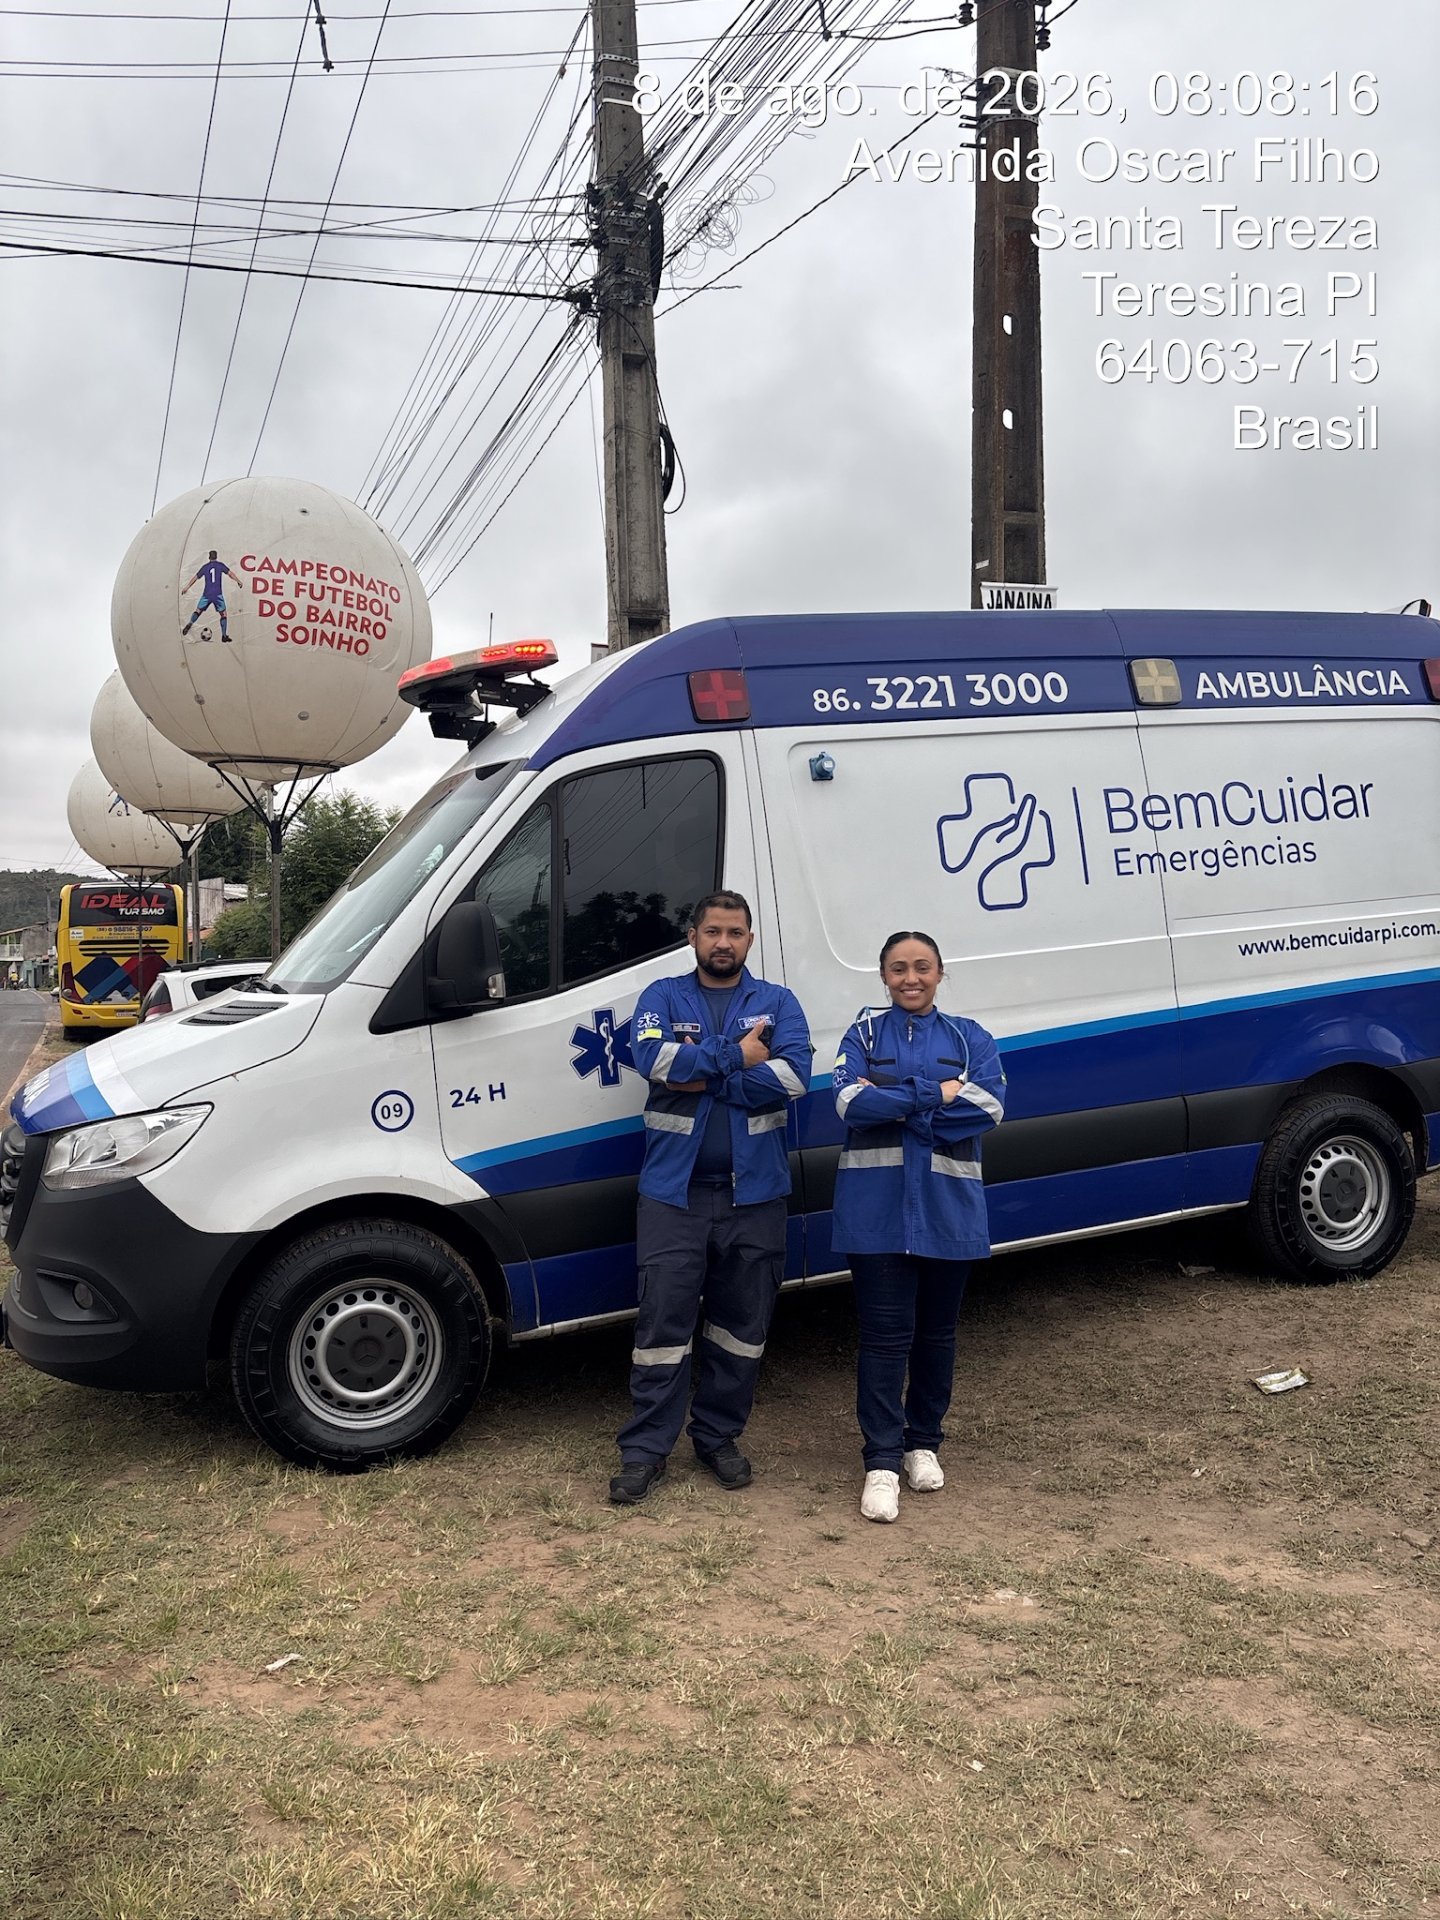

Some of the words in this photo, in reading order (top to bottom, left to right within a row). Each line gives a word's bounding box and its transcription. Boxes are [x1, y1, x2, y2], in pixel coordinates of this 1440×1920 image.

[209, 567, 216, 583] 1
[239, 554, 401, 604] CAMPEONATO
[252, 577, 285, 596] DE
[294, 581, 393, 622] FUTEBOL
[986, 589, 1052, 609] JANAINA
[258, 599, 297, 620] DO
[306, 604, 387, 640] BAIRRO
[276, 623, 370, 656] SOINHO
[812, 688, 862, 713] 86.
[866, 675, 957, 711] 3221
[965, 671, 1069, 707] 3000
[1195, 664, 1411, 700] AMBULÂNCIA
[1102, 772, 1374, 834] BemCuidar
[1113, 836, 1318, 876] Emergências
[80, 895, 167, 909] IDEAL
[118, 908, 165, 916] TURSMO
[380, 1103, 404, 1120] 09
[449, 1086, 482, 1108] 24
[488, 1082, 507, 1102] H
